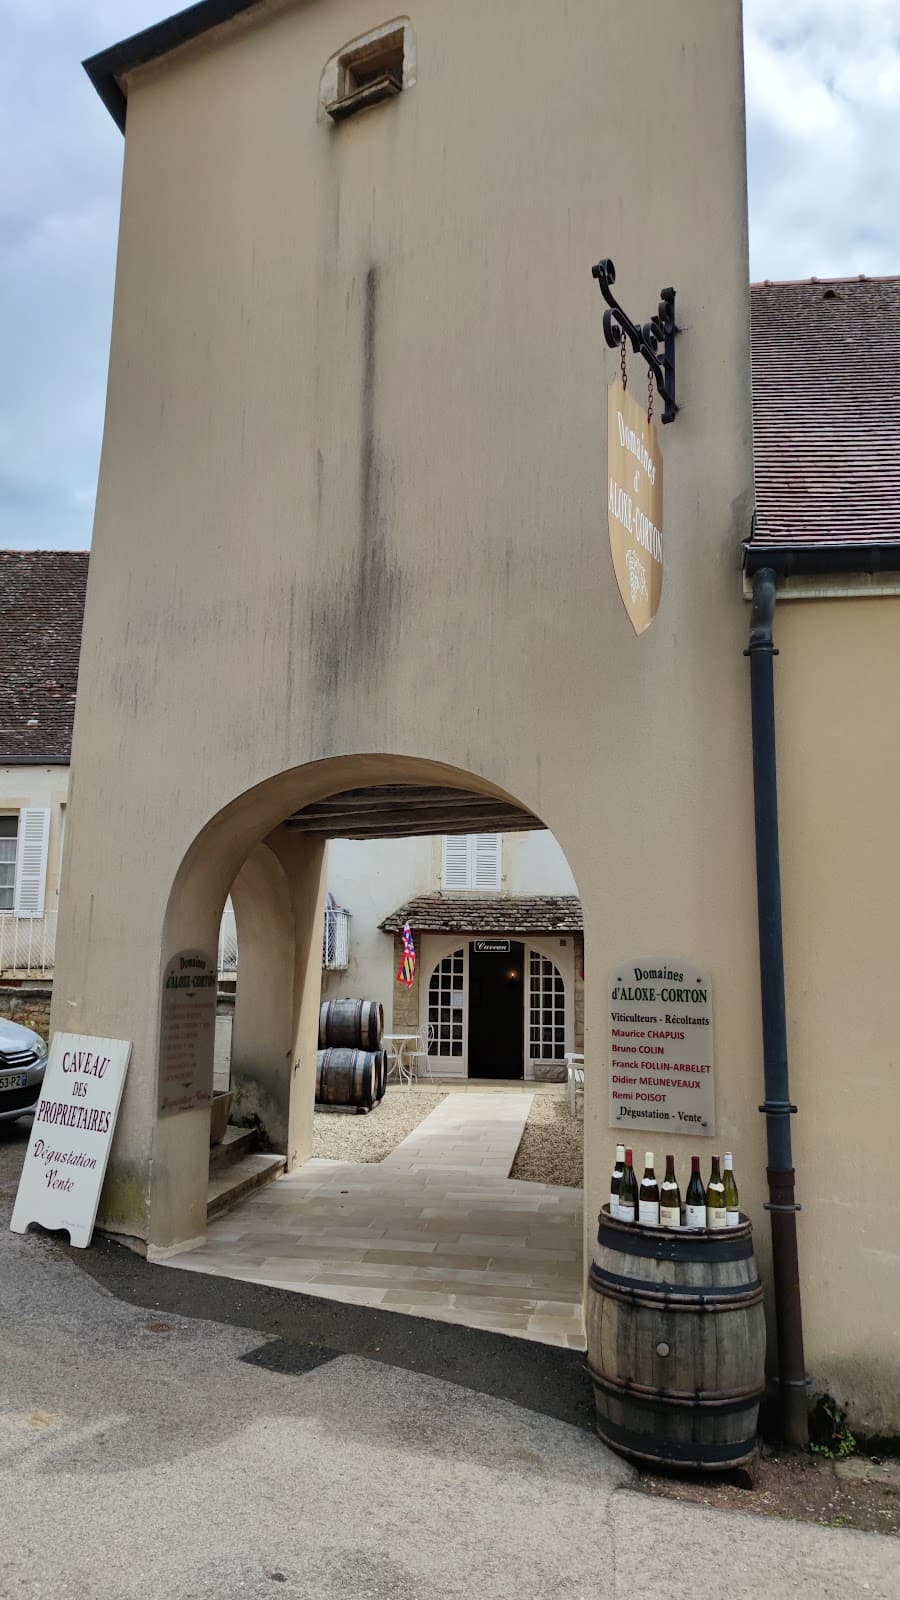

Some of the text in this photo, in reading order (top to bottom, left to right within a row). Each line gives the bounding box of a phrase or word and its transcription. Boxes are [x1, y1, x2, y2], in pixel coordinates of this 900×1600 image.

[616, 411, 656, 486] Domaines
[608, 479, 662, 564] ALOXE-CORTON
[634, 966, 684, 982] Domaines
[611, 987, 707, 1003] d'ALOXE-CORTON
[611, 1012, 657, 1024] Viticulteurs
[665, 1014, 710, 1026] Récoltants
[611, 1029, 685, 1040] Maurice CHAPUIS
[611, 1044, 664, 1055] Bruno COLIN
[62, 1051, 111, 1079] CAVEAU
[612, 1060, 711, 1074] Franck FOLLIN-ARBELET
[72, 1081, 88, 1098] DES
[612, 1076, 701, 1089] Didier MEUNEVEAUX
[635, 1092, 667, 1103] POISOT
[37, 1100, 112, 1134] PROPRIETAIRES
[620, 1106, 670, 1120] Dégustation
[678, 1112, 702, 1123] Vente
[33, 1139, 97, 1170] Dégustation
[44, 1169, 75, 1193] Vente
